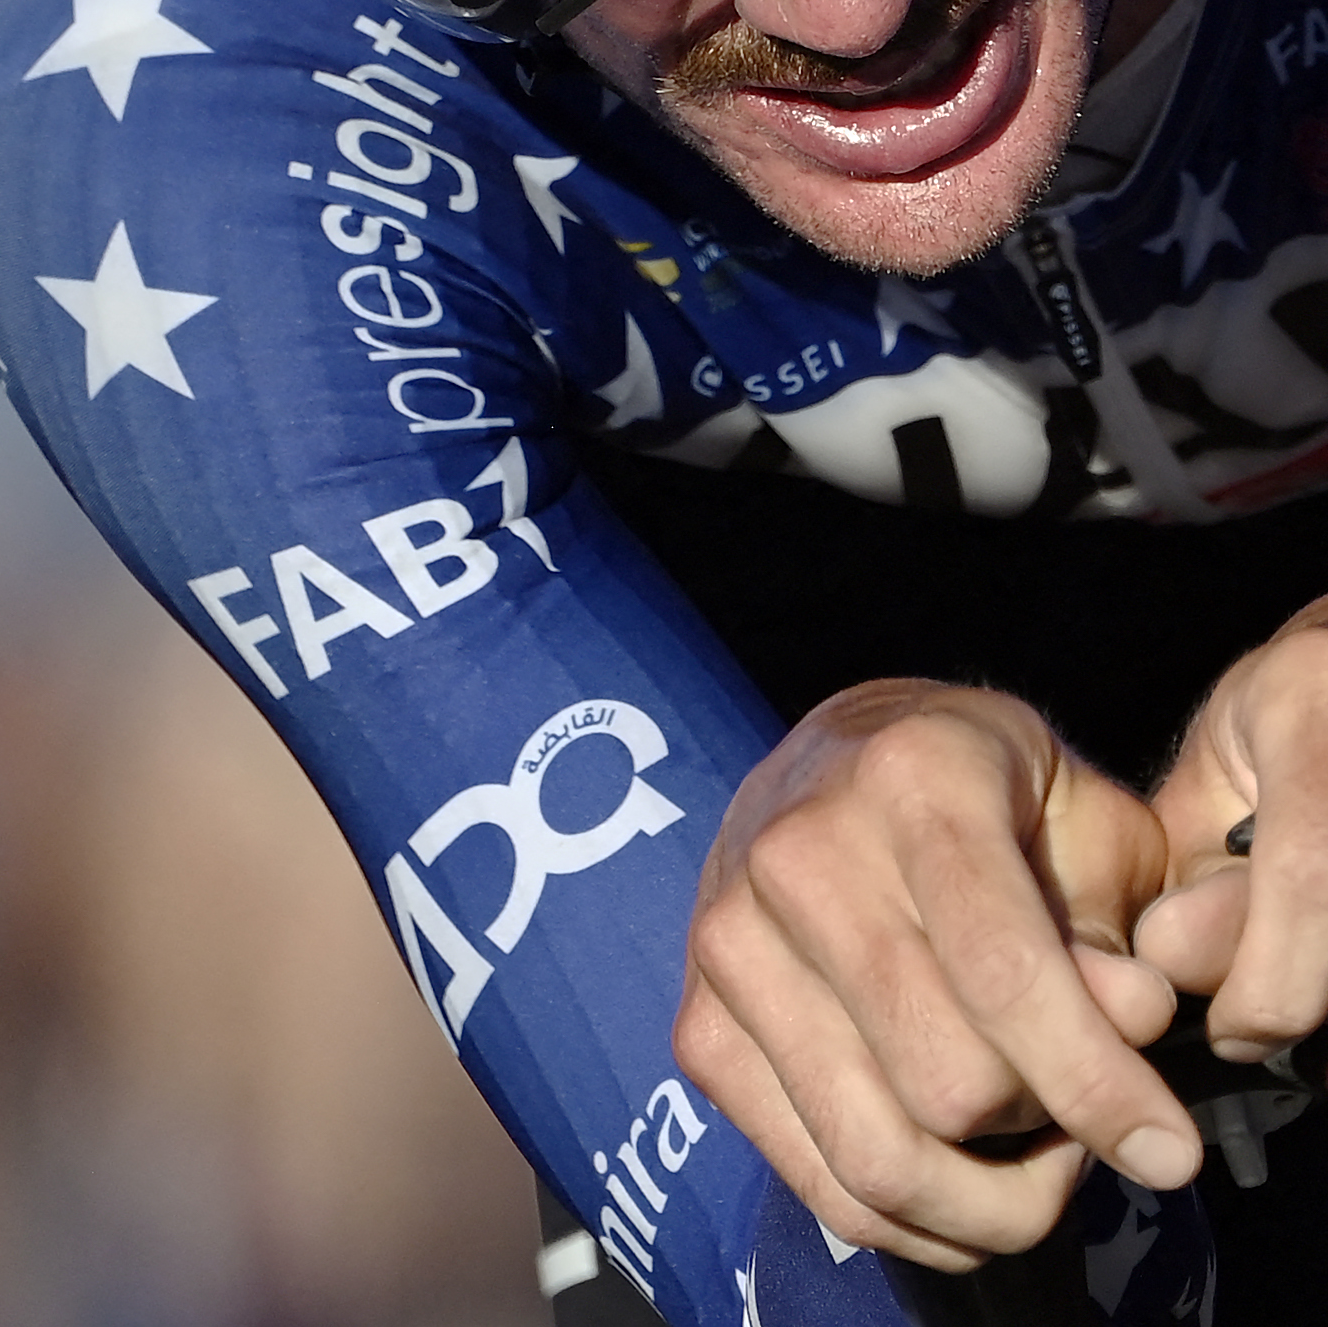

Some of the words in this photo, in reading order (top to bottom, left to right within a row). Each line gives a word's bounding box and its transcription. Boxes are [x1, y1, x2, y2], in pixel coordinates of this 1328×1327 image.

[287, 15, 515, 434] presight
[745, 339, 847, 403] SSEI
[592, 1077, 718, 1315] mira
